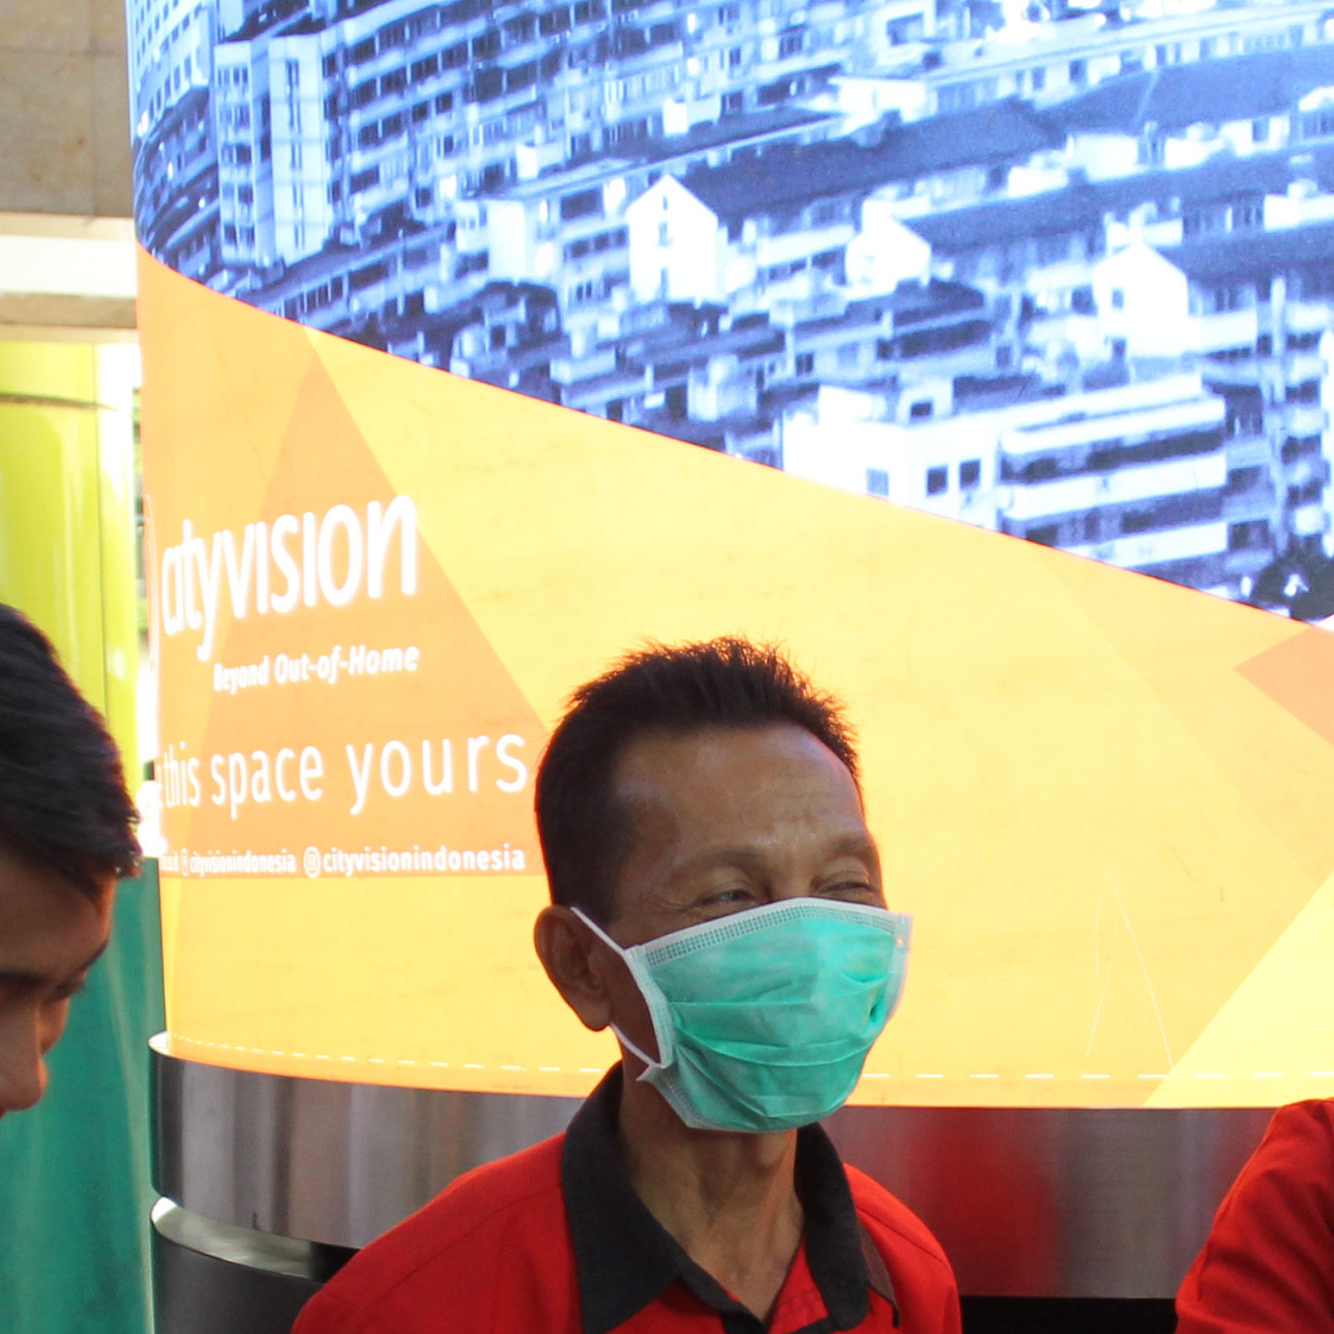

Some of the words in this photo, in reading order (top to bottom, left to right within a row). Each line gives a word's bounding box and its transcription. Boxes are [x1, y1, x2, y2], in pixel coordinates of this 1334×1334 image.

[161, 495, 418, 662] cityvision
[213, 655, 267, 694] Beyond
[274, 645, 420, 684] Out-of-Home
[163, 741, 200, 808] this
[210, 744, 323, 819] space
[345, 733, 528, 815] yours
